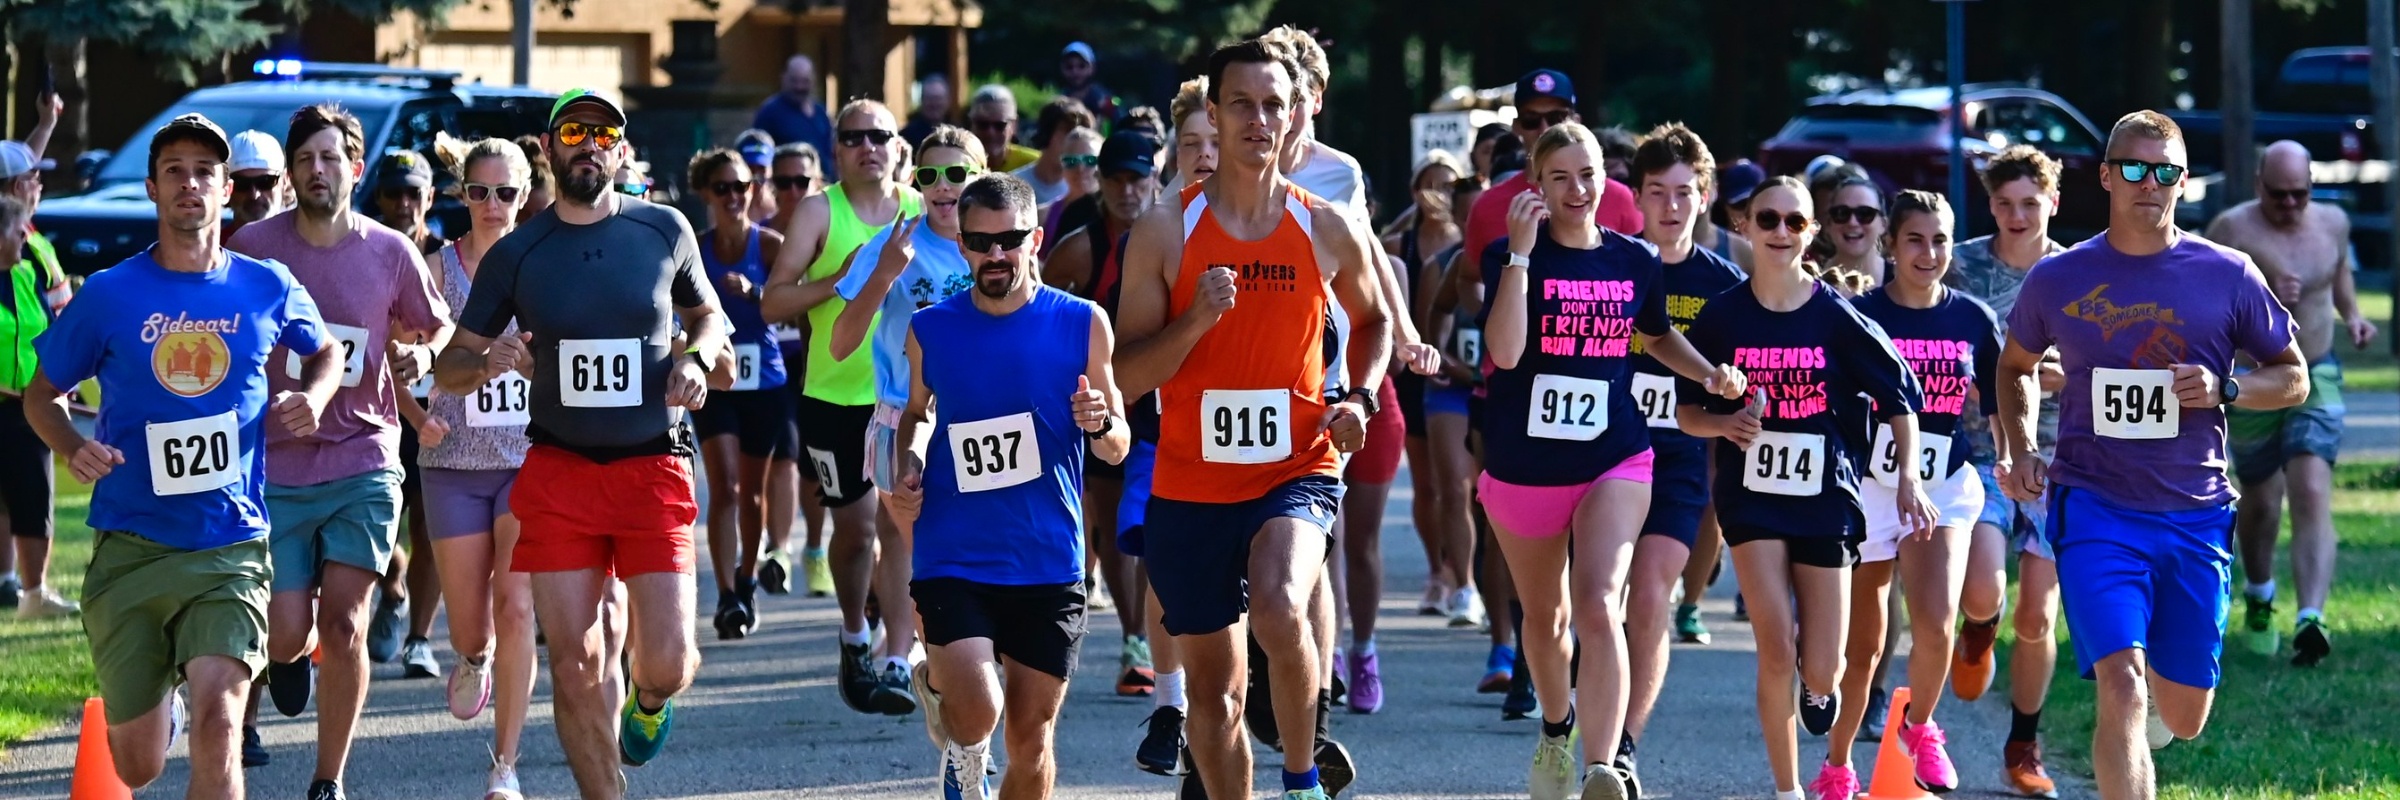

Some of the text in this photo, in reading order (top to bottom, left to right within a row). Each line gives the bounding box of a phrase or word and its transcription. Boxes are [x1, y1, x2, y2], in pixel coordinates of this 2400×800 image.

[1267, 283, 1295, 292] TEAM
[1544, 279, 1634, 302] FRIENDS
[1561, 301, 1622, 316] DON'T LET
[2079, 300, 2107, 317] BE
[141, 310, 241, 343] Sidecar!
[1542, 315, 1633, 337] FRIENDS
[1541, 336, 1576, 356] RUN
[1581, 338, 1629, 357] ALONE
[1733, 347, 1826, 369] FRIENDS
[1891, 338, 1968, 361] RIENDS
[572, 354, 629, 392] 619
[1748, 371, 1812, 384] DON'T LET
[1935, 361, 1956, 374] LET
[477, 379, 526, 413] 613
[1641, 388, 1676, 420] 91
[1779, 396, 1827, 419] ALONE
[1921, 395, 1964, 415] LONE
[2105, 384, 2166, 423] 594
[1541, 389, 1595, 427] 912
[1214, 406, 1277, 447] 916
[163, 430, 229, 479] 620
[962, 430, 1022, 477] 937
[1757, 443, 1811, 481] 914
[1882, 440, 1936, 481] 93
